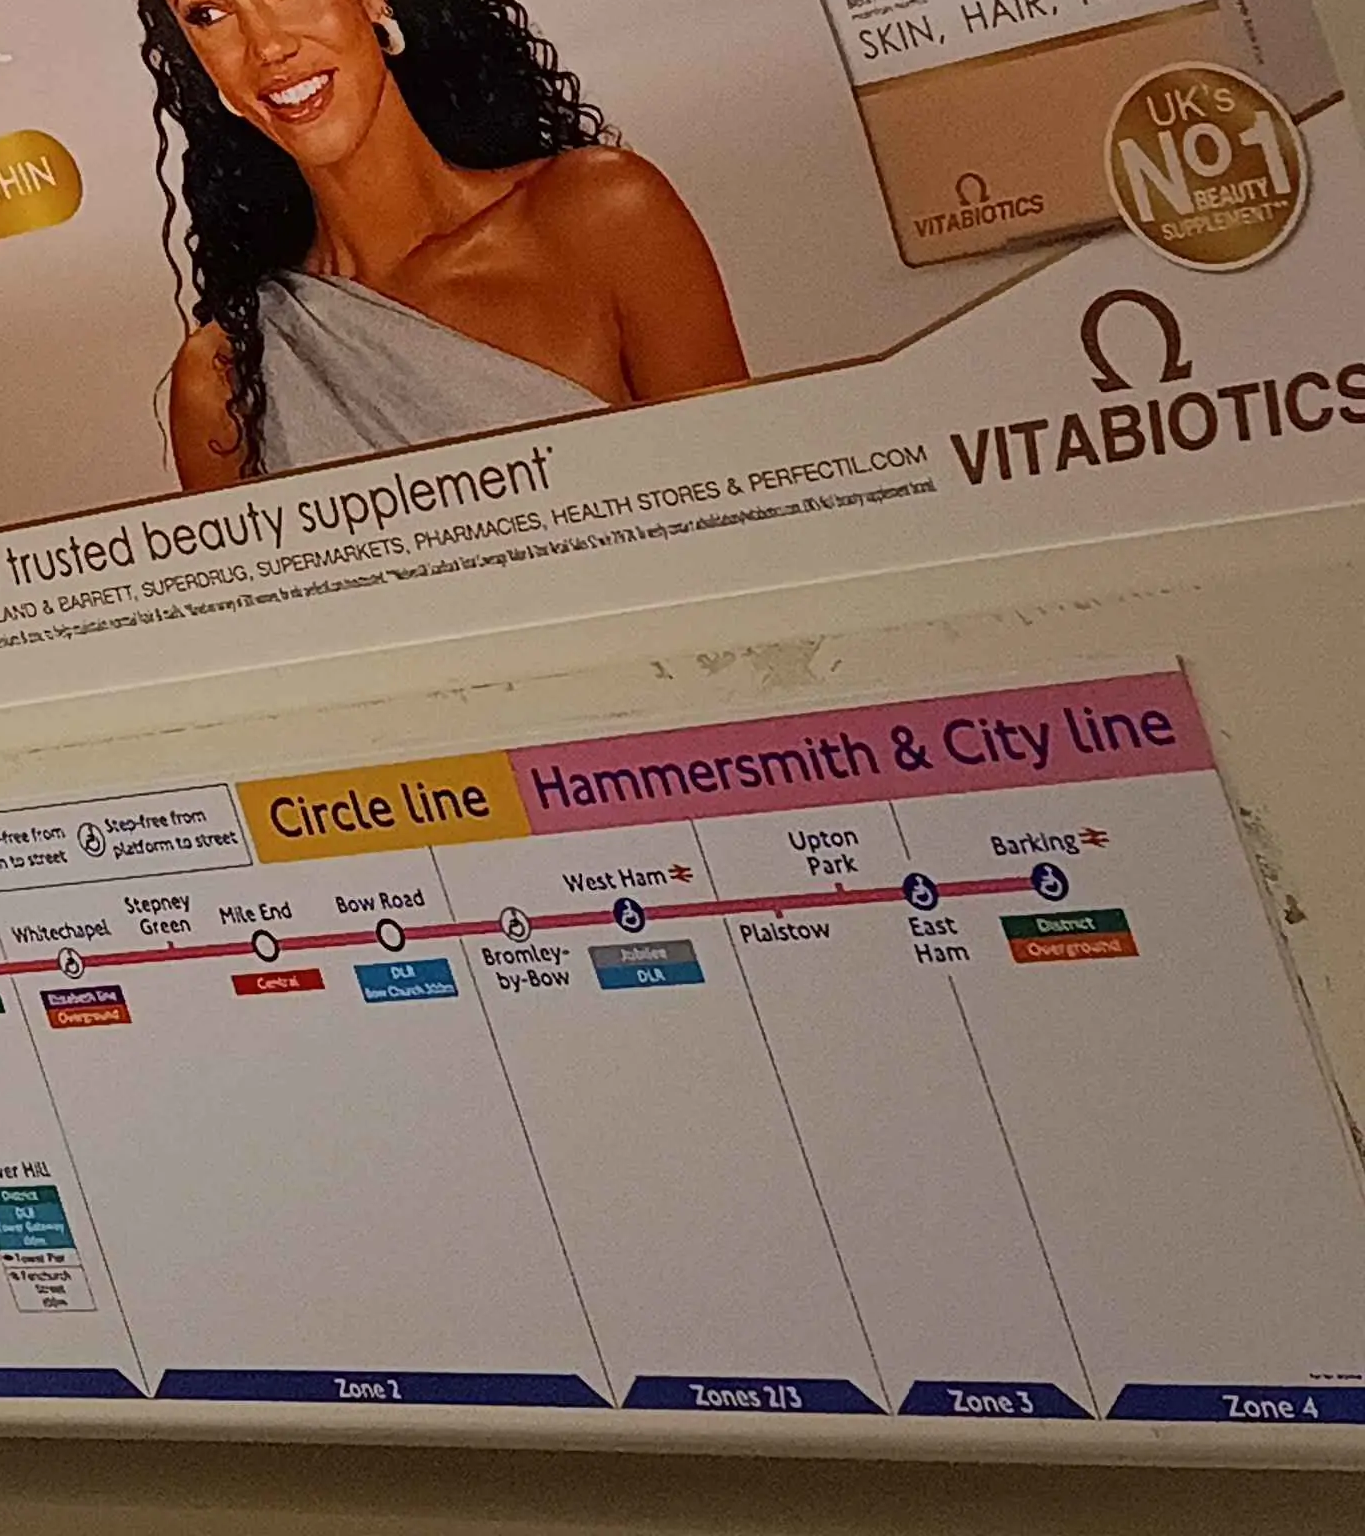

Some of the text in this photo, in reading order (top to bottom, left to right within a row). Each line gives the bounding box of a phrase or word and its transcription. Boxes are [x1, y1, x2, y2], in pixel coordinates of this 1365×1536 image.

[859, 15, 945, 61] SKIN,
[1194, 177, 1268, 211] BEAUTY
[914, 194, 1045, 238] VITABIOTICS
[41, 596, 55, 616] &
[58, 583, 139, 615] BARRETT,
[141, 563, 254, 599] SUPERDRUG,
[256, 537, 411, 579] SUPERMARKETS,
[414, 512, 549, 553] PHARMACIES,
[551, 495, 634, 527] HEALTH
[637, 480, 722, 513] STORES
[726, 476, 744, 498] &
[747, 444, 928, 494] PERFECTIL.COM
[5, 526, 136, 587] trusted
[141, 501, 285, 562] beauty
[530, 707, 1177, 810] Hammersmith & City line
[105, 808, 207, 834] Step-free from
[270, 781, 490, 839] Circle line
[31, 825, 66, 842] from
[112, 831, 239, 860] platform to street
[788, 829, 859, 852] Upton
[991, 833, 1080, 856] Barking
[9, 855, 25, 868] to
[26, 850, 68, 866] street
[806, 855, 859, 876] Park
[563, 867, 667, 893] West Ham
[124, 894, 191, 915] Stepney
[219, 901, 293, 925] Mile End
[335, 888, 425, 914] Bow Road
[11, 919, 112, 944] Whitechapel
[139, 917, 191, 936] Green
[739, 921, 831, 943] Plaistow
[908, 916, 959, 937] East
[1035, 916, 1096, 934] District
[481, 946, 570, 966] Bromley-
[914, 944, 970, 964] Ham
[1027, 938, 1122, 958] Overground
[256, 975, 301, 990] Central
[496, 969, 571, 993] by-Bow
[636, 967, 666, 985] DLR
[20, 1160, 52, 1180] Hill
[334, 1377, 403, 1401] Zone 2
[689, 1383, 803, 1411] Zones 2/3
[946, 1388, 1035, 1415] Zone 3
[1222, 1393, 1320, 1419] Zone 4
